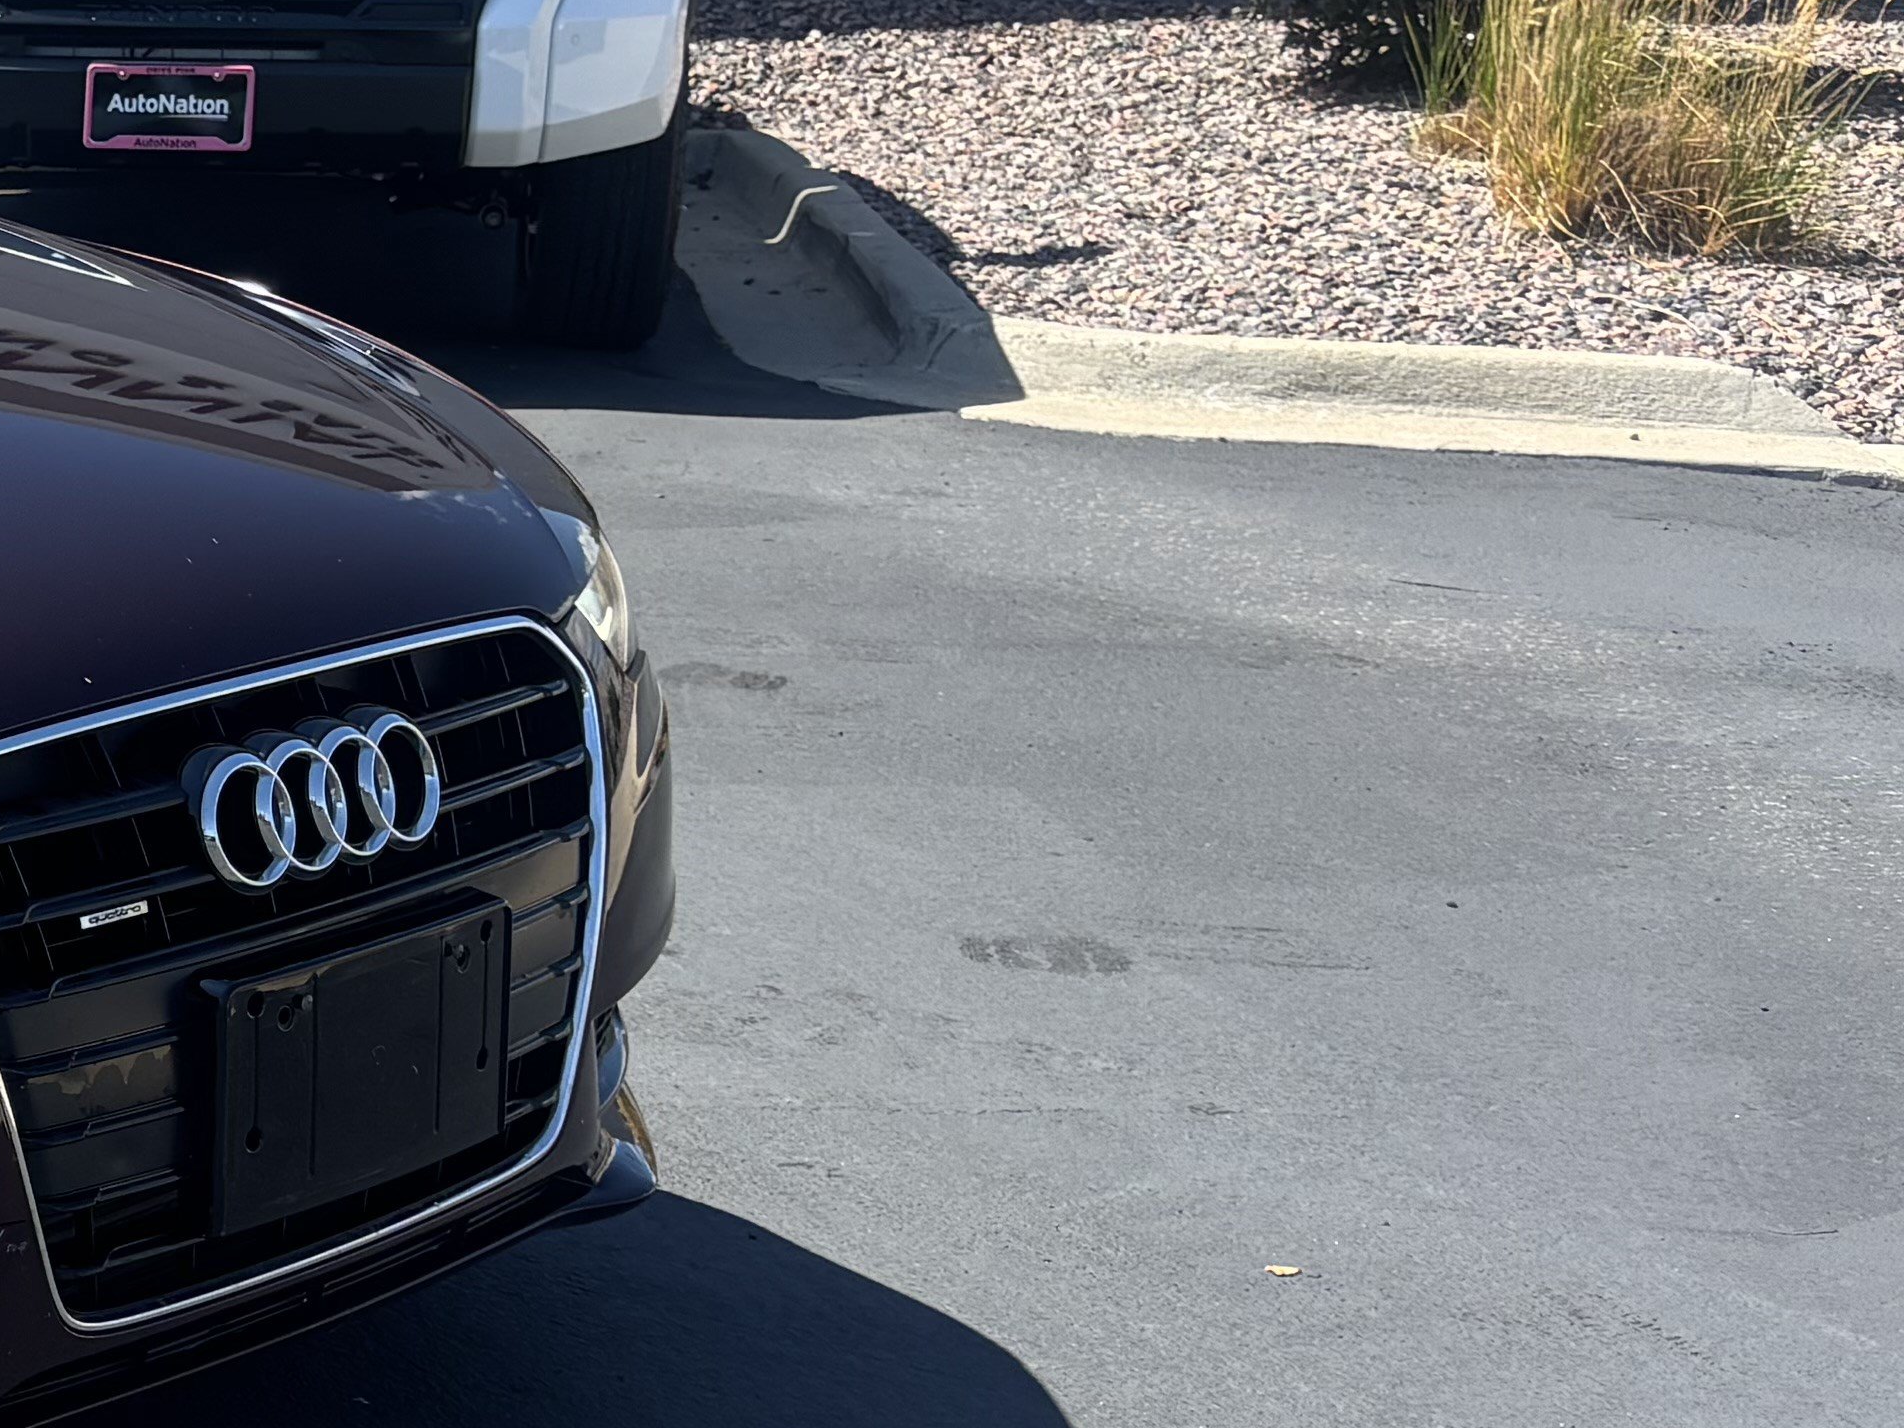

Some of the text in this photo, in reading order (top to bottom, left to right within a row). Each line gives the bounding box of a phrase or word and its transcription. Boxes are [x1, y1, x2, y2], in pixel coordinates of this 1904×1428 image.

[106, 92, 230, 114] AutoNation
[133, 137, 197, 150] AutoNation
[88, 905, 142, 925] quattro
